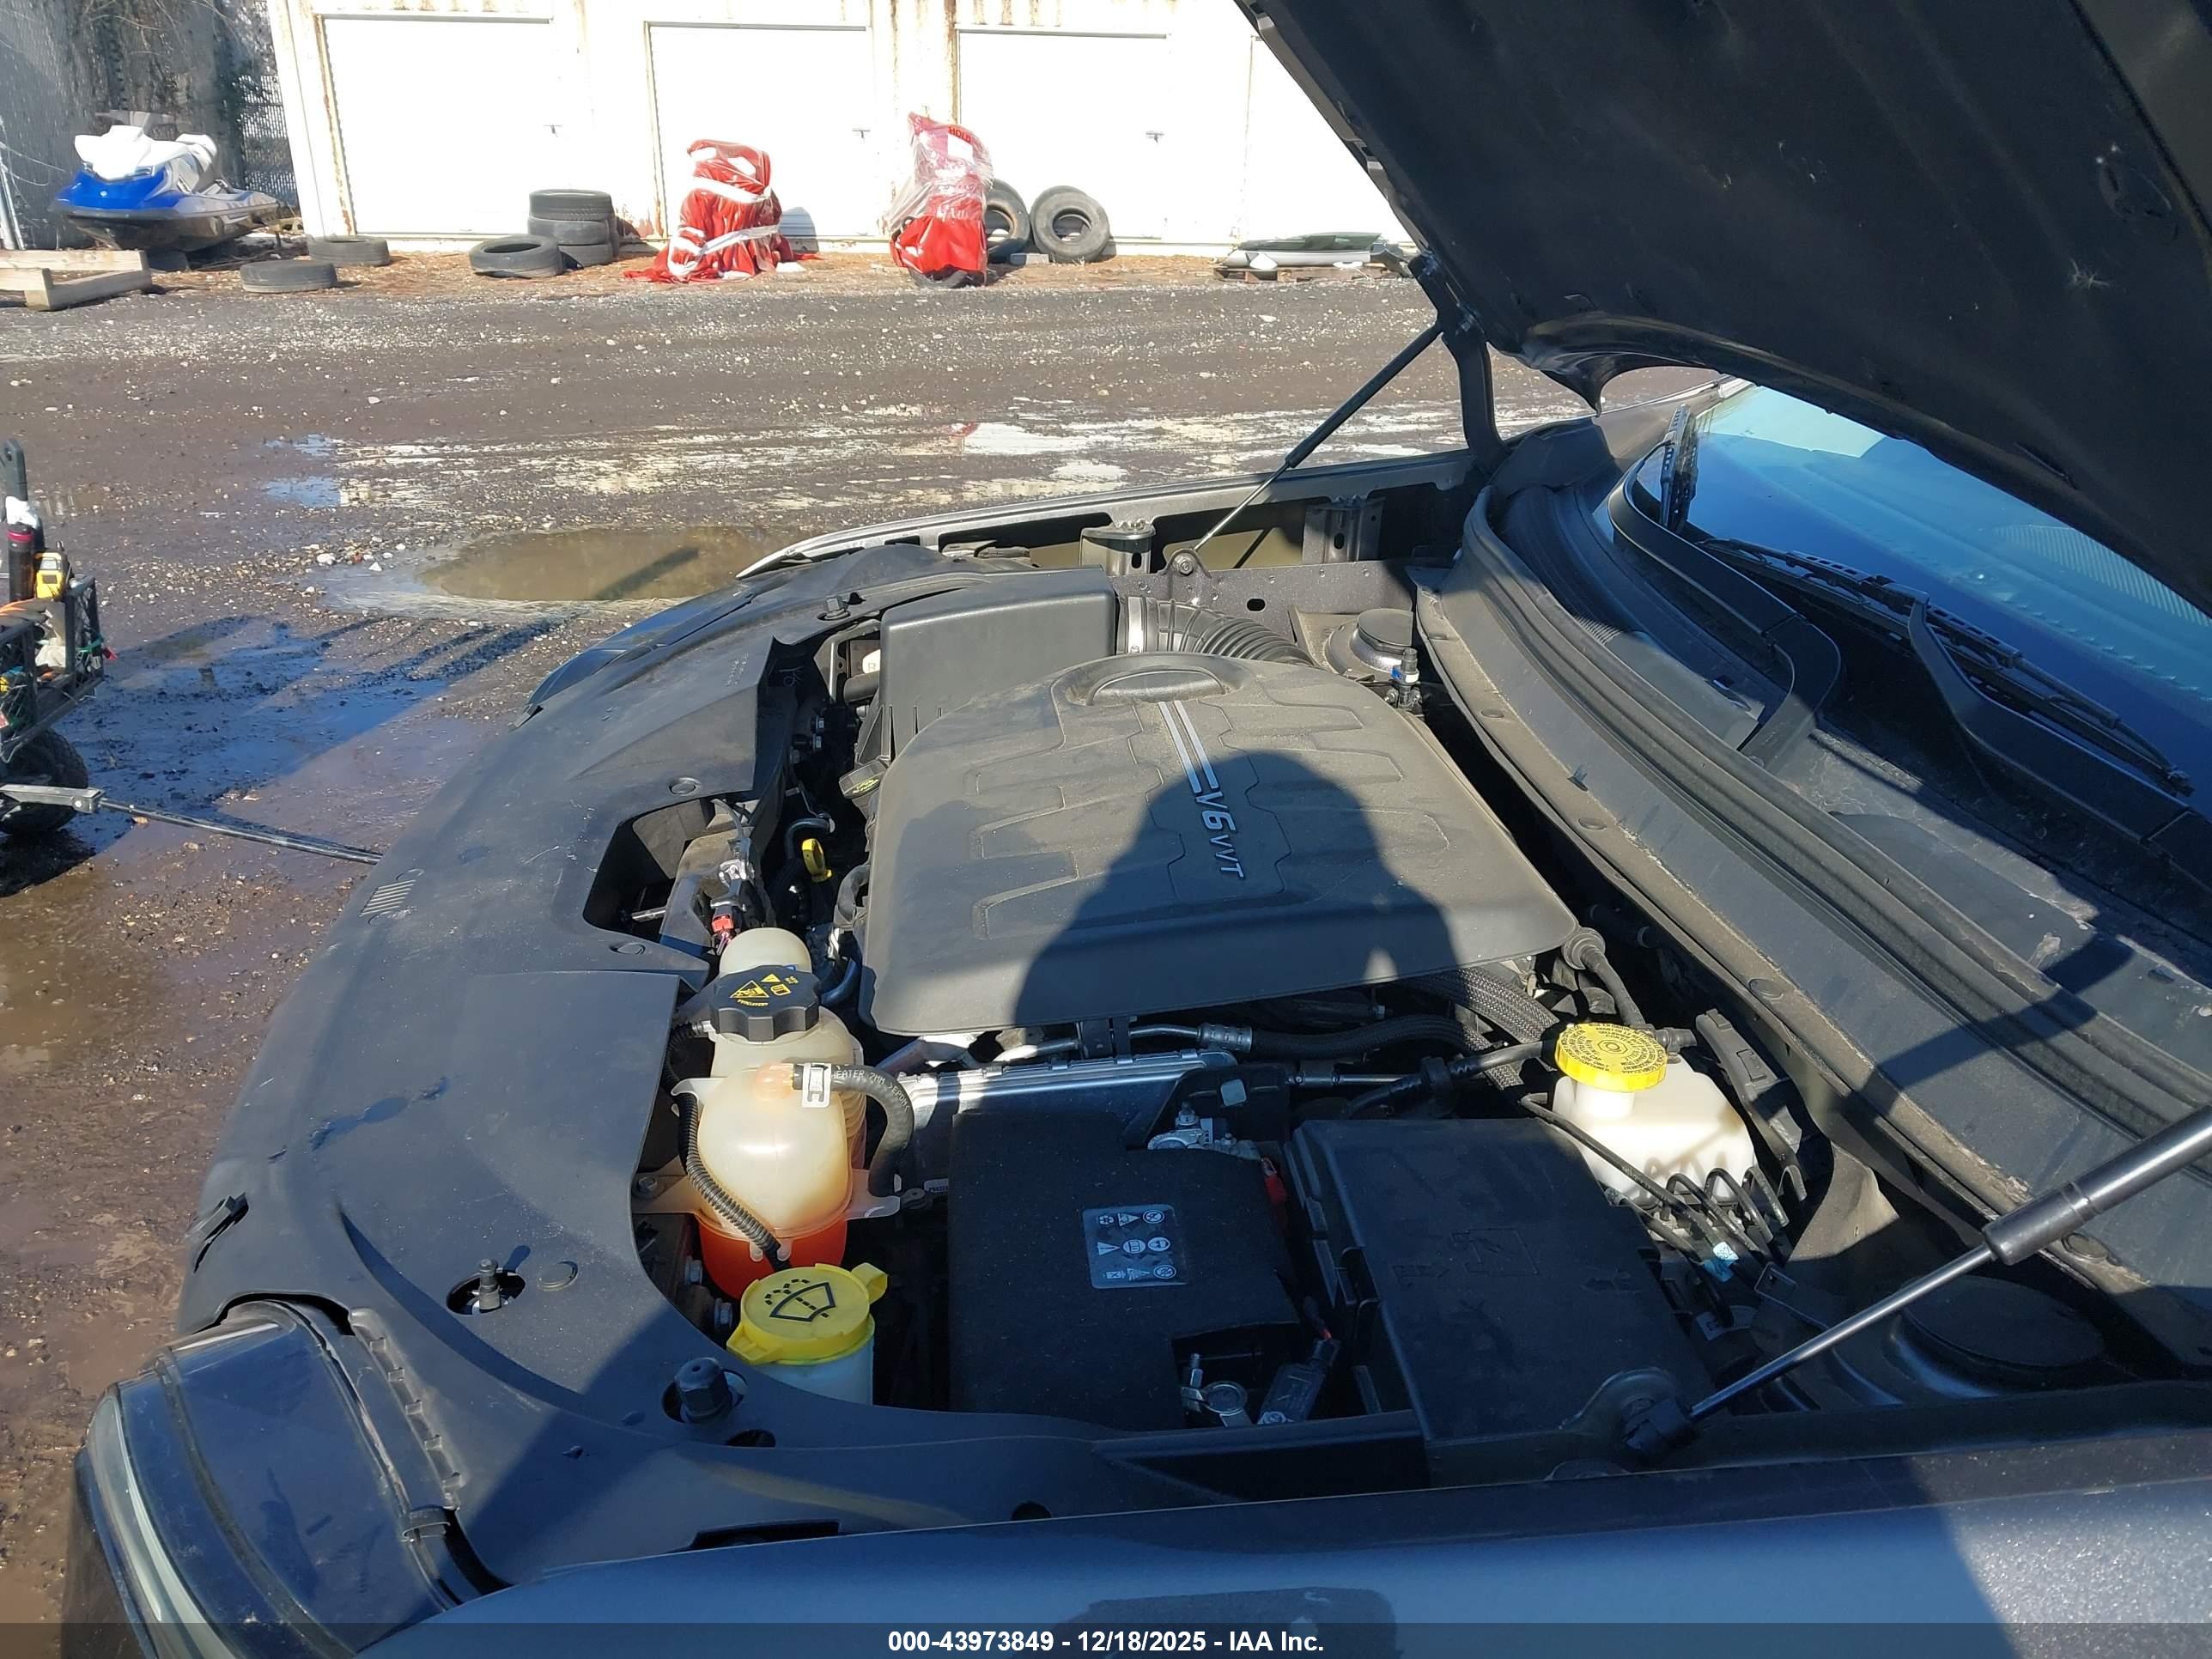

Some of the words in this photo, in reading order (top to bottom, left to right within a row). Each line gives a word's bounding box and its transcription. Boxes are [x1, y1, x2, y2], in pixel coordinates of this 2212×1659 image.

[948, 126, 971, 143] HOLD
[1195, 791, 1237, 832] V6
[1209, 834, 1246, 879] VVT
